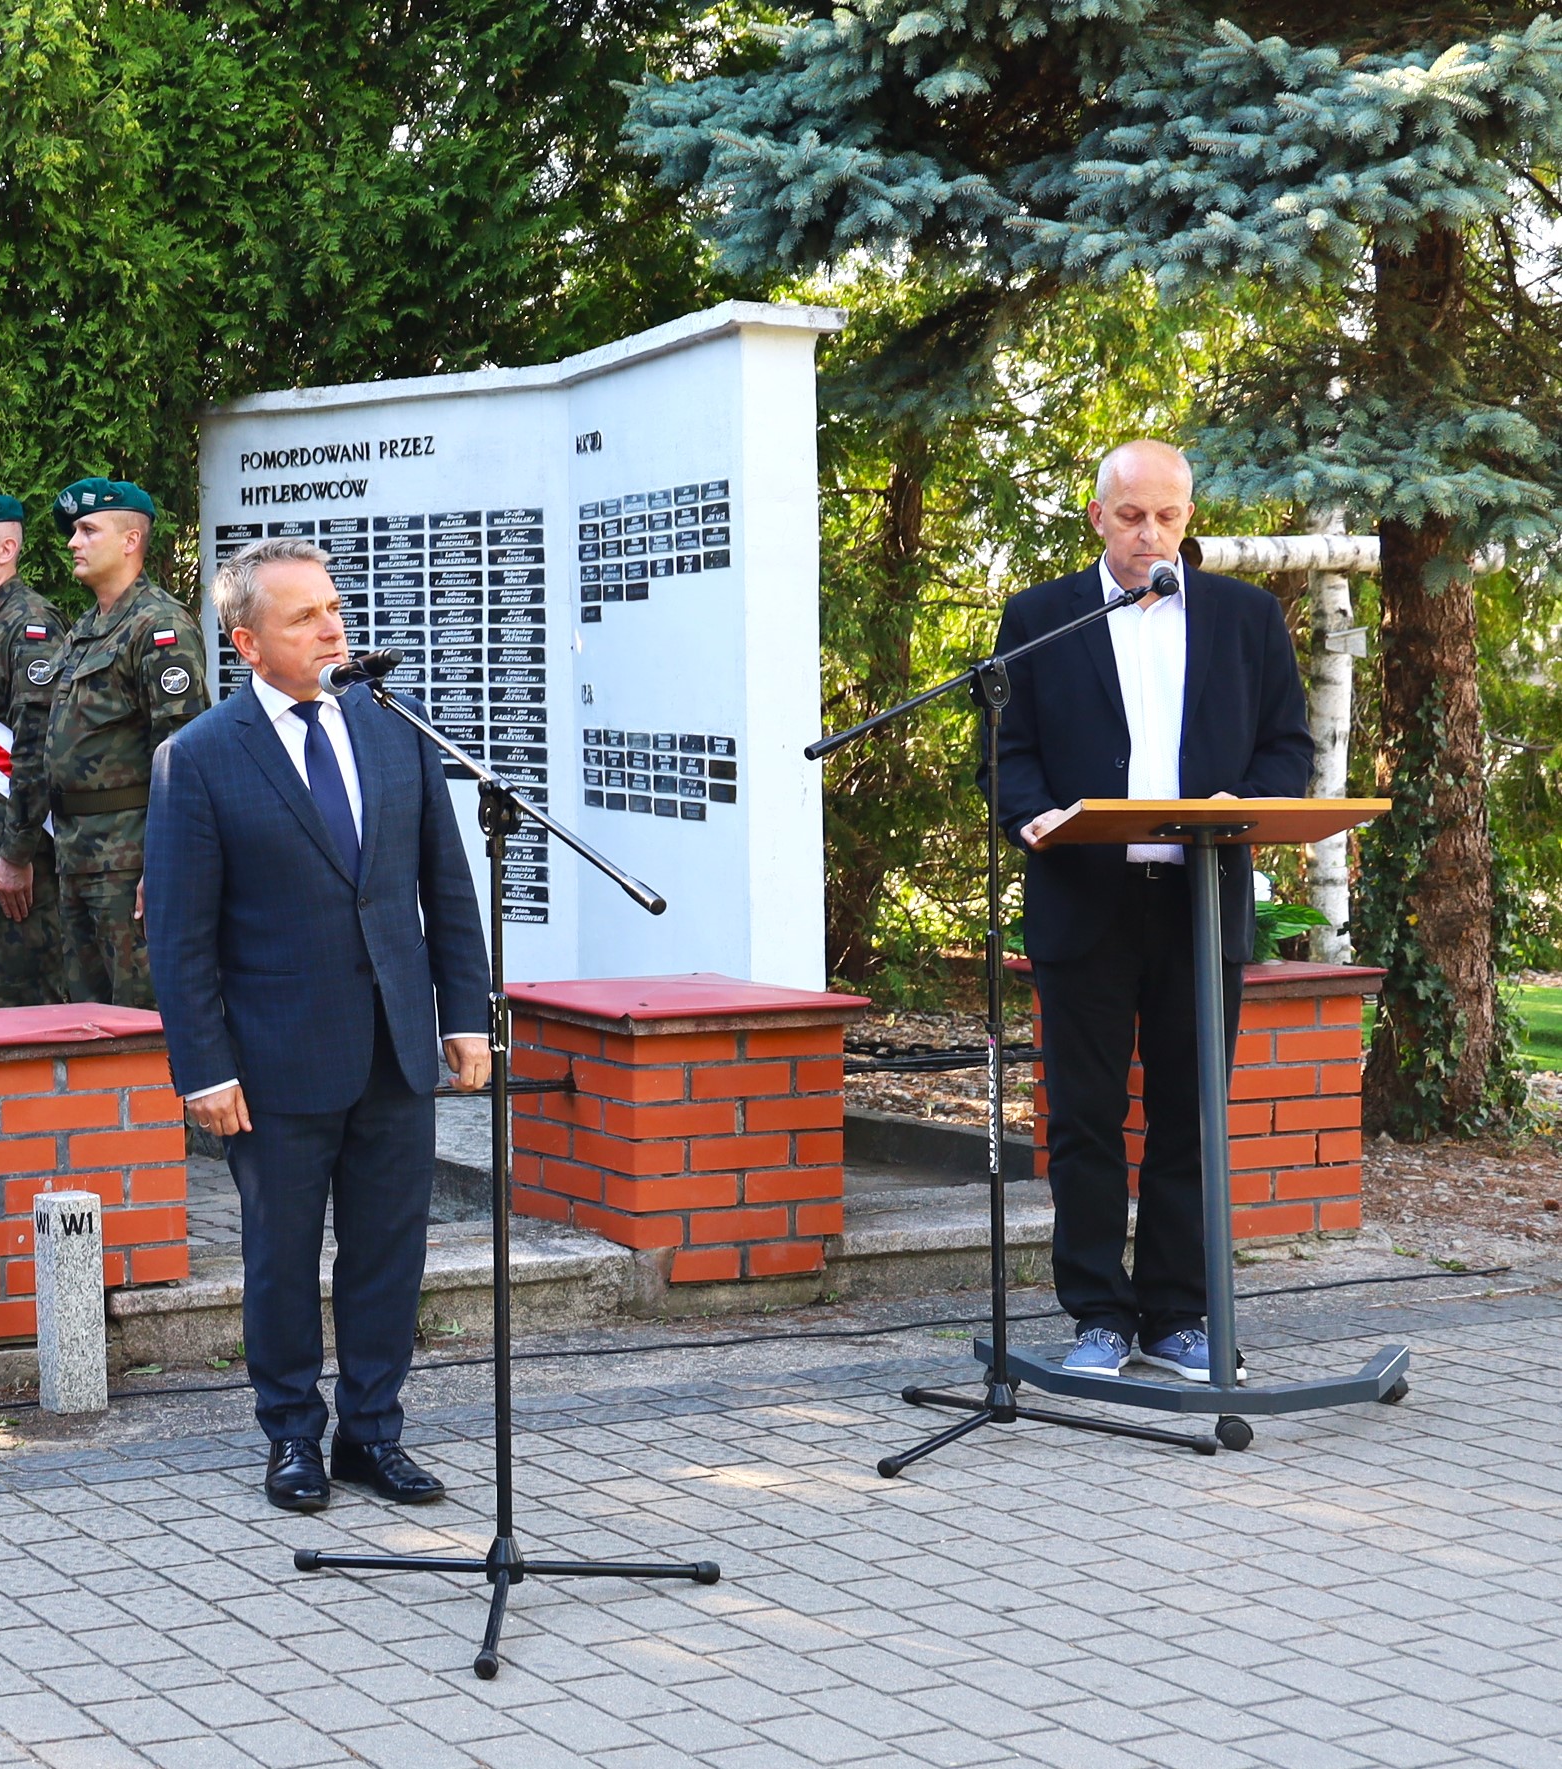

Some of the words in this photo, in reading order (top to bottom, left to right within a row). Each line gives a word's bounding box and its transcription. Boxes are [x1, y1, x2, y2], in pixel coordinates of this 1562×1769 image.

[240, 440, 371, 472] POMORDOWANI
[379, 435, 436, 460] PRZEZ
[240, 472, 369, 506] HITLEROWCÓW
